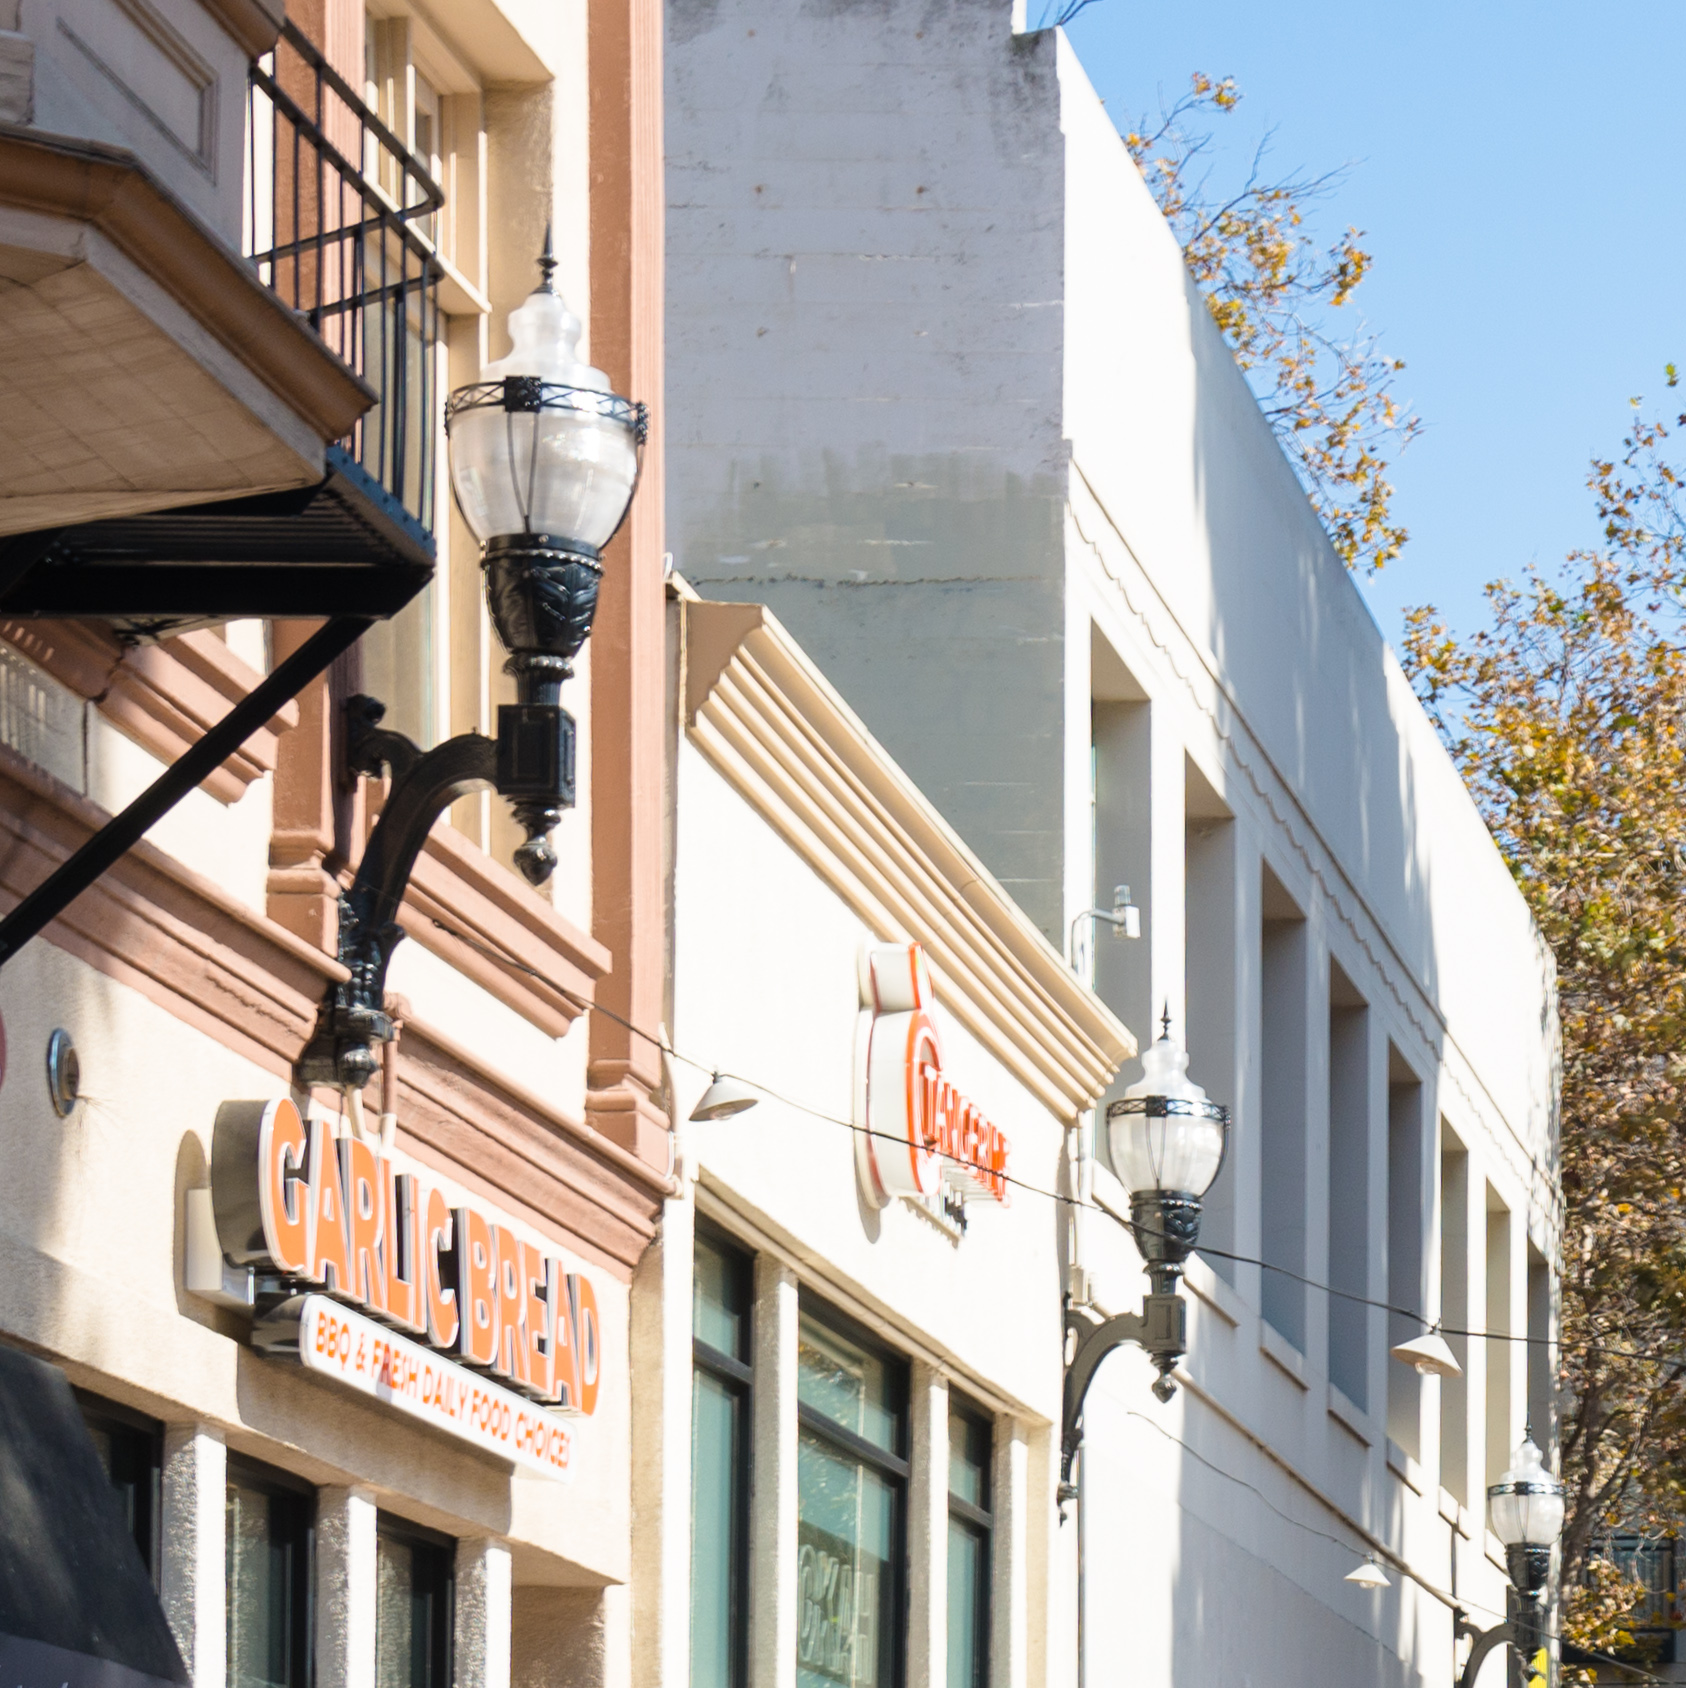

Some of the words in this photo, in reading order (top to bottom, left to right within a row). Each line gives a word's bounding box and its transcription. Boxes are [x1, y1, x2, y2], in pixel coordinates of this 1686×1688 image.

[260, 1098, 459, 1348] GARLIC
[464, 1208, 601, 1417] BREAD
[315, 1310, 350, 1372] BBQ
[355, 1332, 366, 1374] &
[371, 1339, 420, 1399] FRESH
[422, 1364, 469, 1420] DAILY
[470, 1388, 512, 1442] FOOD
[515, 1411, 571, 1469] CHOICES
